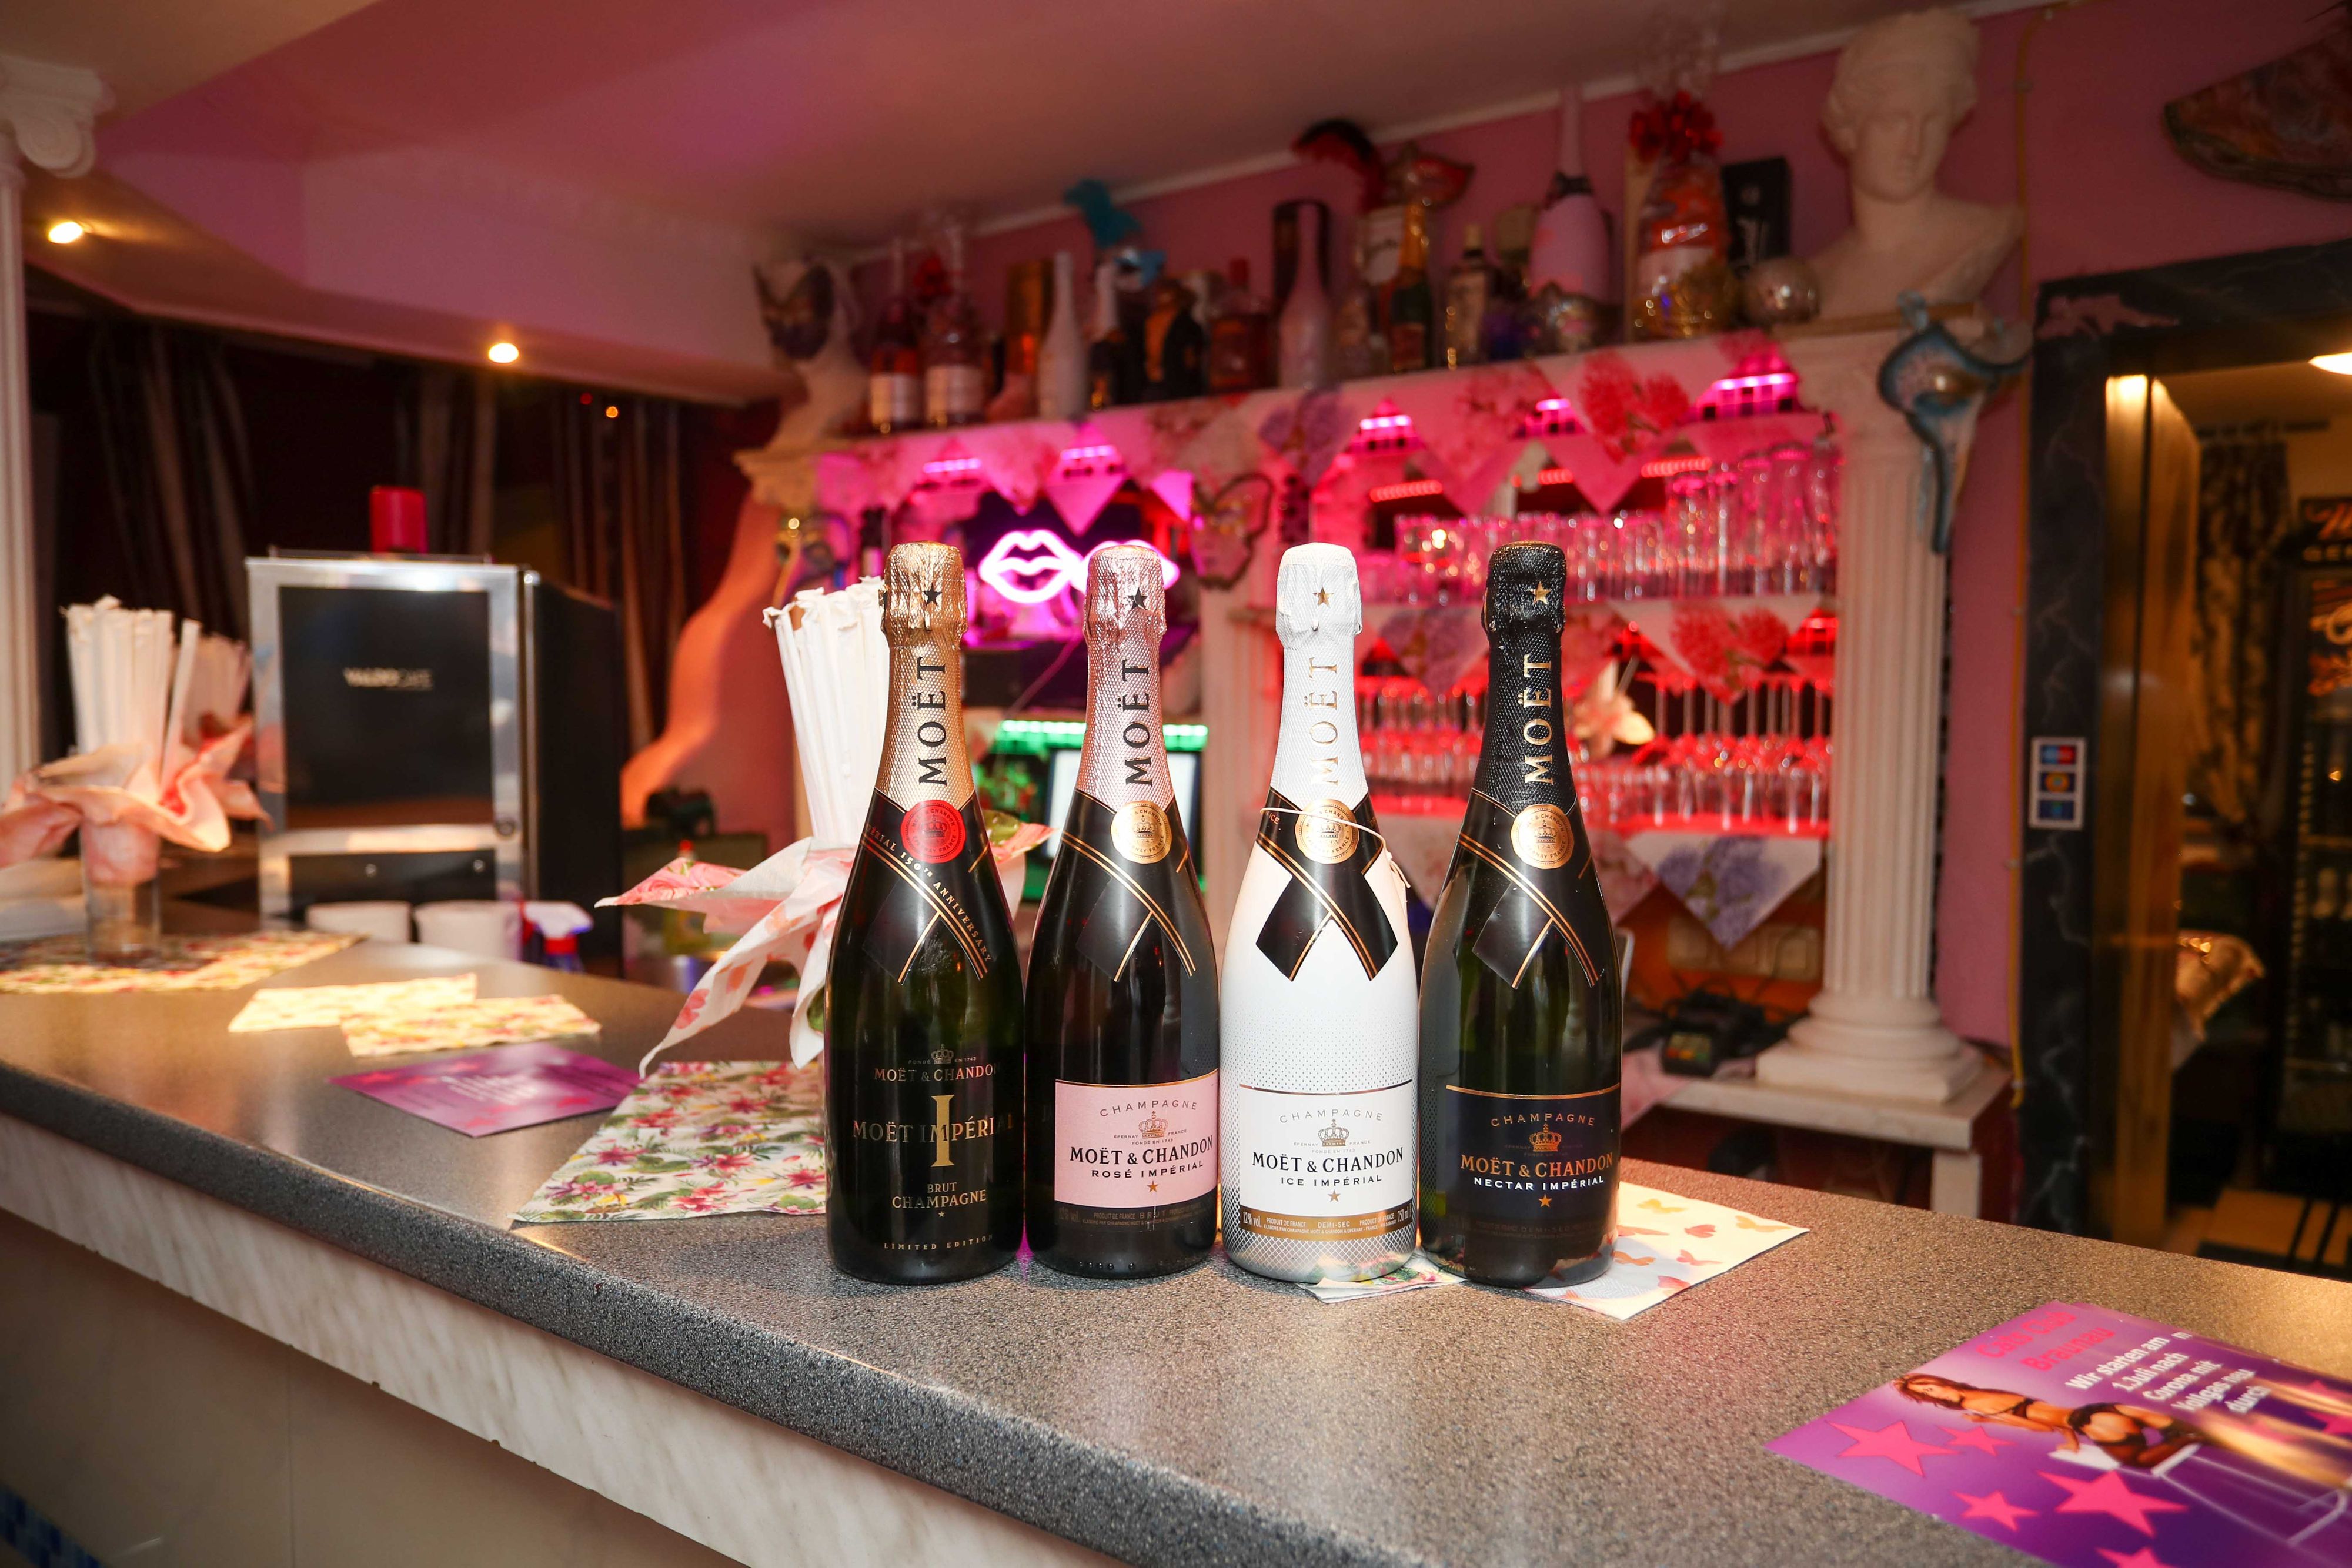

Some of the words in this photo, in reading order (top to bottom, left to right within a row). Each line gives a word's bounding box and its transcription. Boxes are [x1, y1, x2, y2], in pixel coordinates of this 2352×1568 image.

[911, 656, 947, 787] MOËT
[1117, 659, 1152, 787] MOËT
[1303, 657, 1339, 786] MOËT
[1518, 654, 1553, 785] MOËT
[1140, 809, 1162, 826] CHANDON
[1541, 814, 1563, 832] CHANDON
[1149, 835, 1164, 853] FRANCE
[1332, 837, 1349, 853] FRANCE
[1550, 841, 1565, 859] FRANCE
[933, 882, 992, 962] ANNIVERSARY
[874, 1068, 917, 1082] MOËT
[921, 1071, 930, 1082] &
[1100, 1100, 1197, 1117] CHAMPAGNE
[1280, 1109, 1382, 1124] CHAMPAGNE
[853, 1119, 913, 1143] MOËT
[931, 1094, 956, 1167] I
[1491, 1113, 1595, 1127] CHAMPAGNE
[1070, 1146, 1123, 1165] MOËT
[1127, 1153, 1138, 1165] &
[1142, 1135, 1213, 1164] CHANDON
[1252, 1152, 1302, 1172] MOËT
[1307, 1161, 1317, 1173] &
[1322, 1147, 1403, 1173] CHANDON
[1091, 1168, 1132, 1178] ROSÉ
[1141, 1160, 1204, 1178] IMPÉRIAL
[1460, 1154, 1514, 1176] MOËT
[1519, 1165, 1530, 1177] &
[1535, 1152, 1613, 1177] CHANDON
[927, 1182, 957, 1193] BRUT
[1281, 1177, 1304, 1186] ICE
[1314, 1175, 1382, 1186] IMPÉRIAL
[1474, 1176, 1534, 1191] NECTAR
[1543, 1176, 1603, 1190] IMPÉRIAL
[892, 1189, 987, 1209] CHAMPAGNE
[1243, 1211, 1252, 1226] 12%
[1254, 1215, 1262, 1228] vol.
[1266, 1217, 1282, 1225] PRODUIT
[947, 1235, 993, 1249] EDITION
[1976, 1331, 2033, 1358] Cats
[2019, 1327, 2115, 1372] Braunau
[2064, 1372, 2103, 1390] Wir
[2096, 1349, 2148, 1376] starten
[2141, 1336, 2170, 1353] am
[2150, 1352, 2190, 1377] nach
[2143, 1372, 2200, 1402] Corona
[2190, 1360, 2224, 1376] mit
[2224, 1385, 2271, 1413] durch
